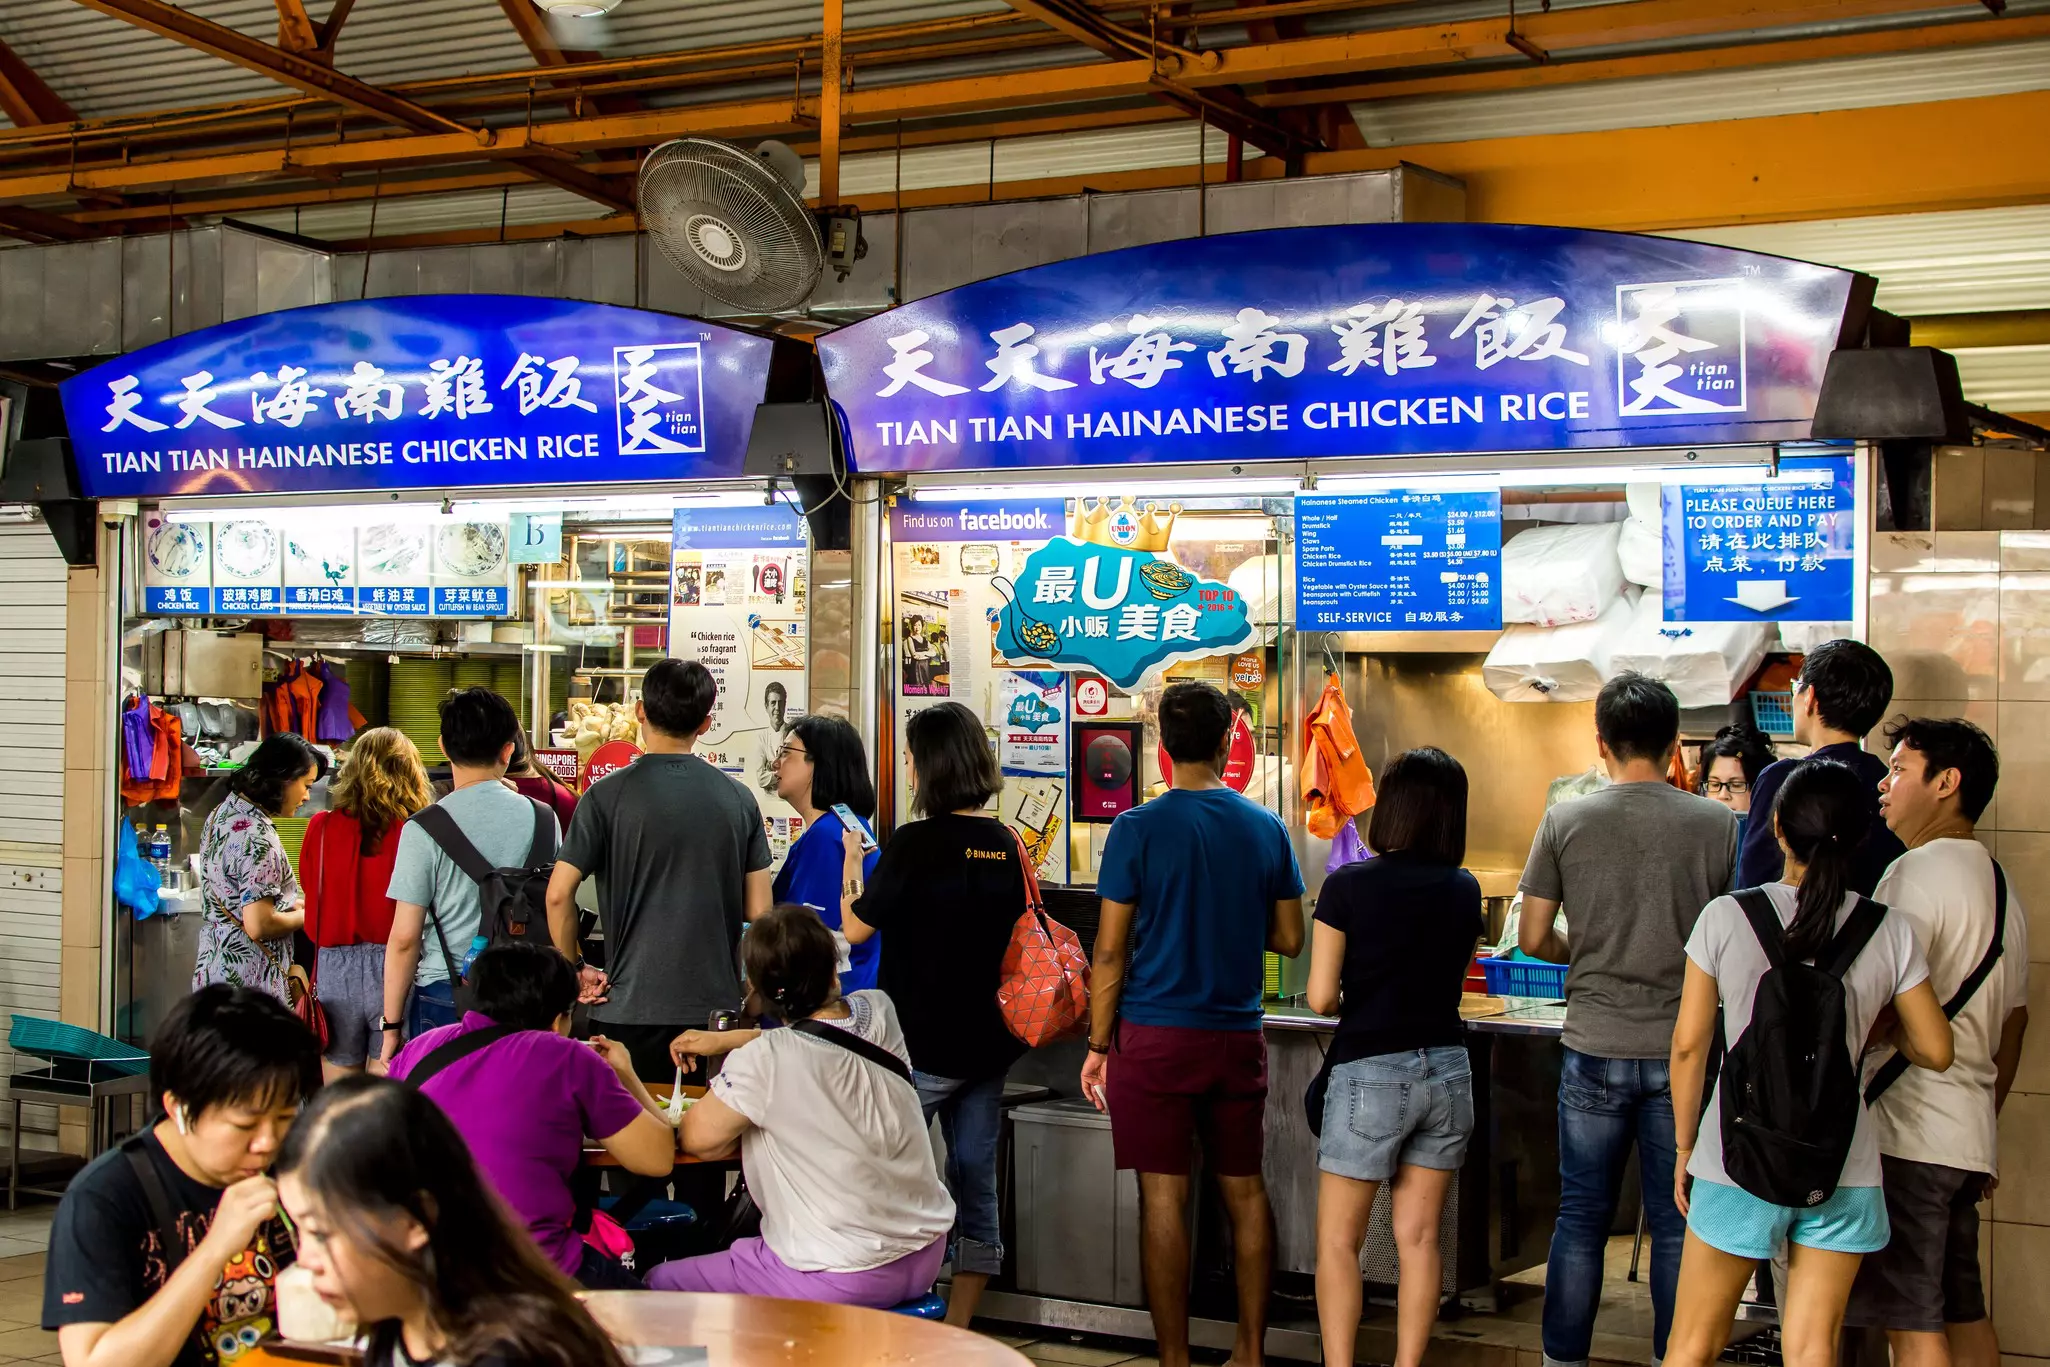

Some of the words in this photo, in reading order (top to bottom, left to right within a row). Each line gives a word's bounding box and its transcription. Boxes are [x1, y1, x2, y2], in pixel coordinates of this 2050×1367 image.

[699, 332, 712, 342] TM
[1690, 361, 1728, 376] tian
[1697, 376, 1735, 391] tian
[665, 410, 692, 423] tian
[877, 419, 957, 446] TIAN
[969, 415, 1052, 442] TIAN
[1067, 404, 1288, 438] HAINANESE
[1302, 395, 1484, 429] CHICKEN
[1500, 391, 1590, 422] RICE
[671, 423, 697, 435] tian
[102, 451, 161, 474] TIAN
[168, 448, 229, 472] TIAN
[238, 442, 394, 469] HAINANESE
[402, 436, 527, 464] CHICKEN
[538, 434, 599, 459] RICE
[1686, 498, 1738, 513] PLEASE
[1743, 497, 1793, 512] QUEUE
[1798, 496, 1836, 509] HERE
[1474, 510, 1496, 518] $12.00
[903, 514, 924, 528] Find
[927, 517, 938, 528] us
[940, 516, 953, 528] on
[1447, 519, 1464, 527] $3.50
[1687, 516, 1706, 529] TO
[1712, 515, 1763, 529] ORDER
[1767, 514, 1802, 528] AND
[1807, 513, 1839, 527] PAY
[525, 515, 545, 546] B
[681, 523, 792, 533] www.tiantianchickenrice.com
[1302, 530, 1316, 538] Wing
[1698, 532, 1829, 551] 请在此排队
[222, 588, 273, 602] 玻璃鸡脚
[296, 588, 343, 602] 香滑白鸡
[1198, 589, 1219, 602] TOP
[1221, 590, 1234, 602] 10
[157, 602, 185, 610] CHICKEN
[222, 602, 250, 610] CHICKEN
[362, 603, 386, 611] VEGETABLE
[394, 603, 411, 611] OYSTER
[411, 603, 427, 611] SAUCE
[438, 603, 465, 611] CUTTLEFISH
[473, 603, 485, 611] BEAN
[486, 603, 504, 611] SPROUT
[1317, 612, 1392, 623] SELF-SERVICE
[1405, 611, 1464, 623] 自助服务
[723, 632, 735, 641] rice
[701, 645, 708, 653] so
[709, 644, 737, 655] fragrant
[701, 656, 729, 665] delicious
[1234, 671, 1254, 683] yelp
[903, 683, 928, 694] Women's
[928, 684, 949, 696] Weekly
[554, 766, 575, 776] FOODS
[973, 850, 1007, 860] BINANCE
